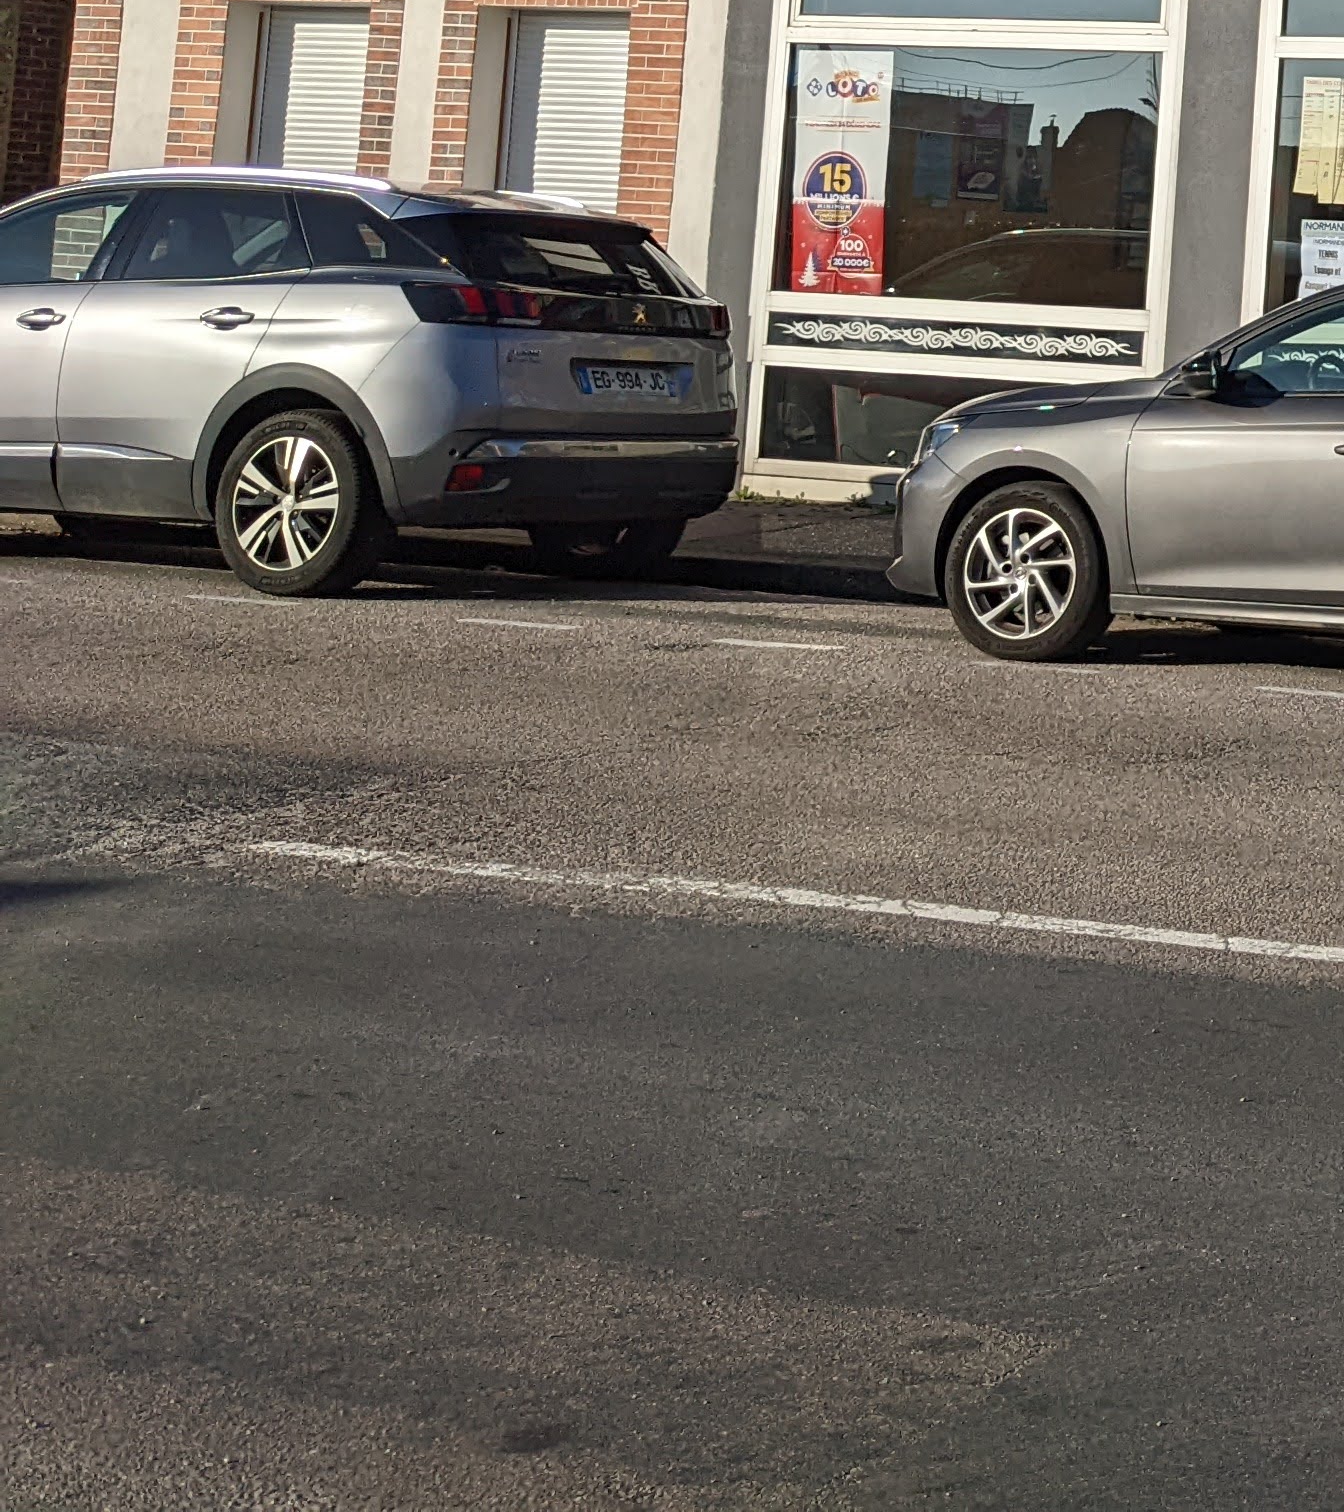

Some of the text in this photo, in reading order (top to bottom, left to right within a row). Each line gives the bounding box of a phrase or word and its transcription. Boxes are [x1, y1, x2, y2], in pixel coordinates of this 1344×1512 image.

[826, 76, 879, 98] LOTO
[819, 162, 852, 193] 15
[839, 239, 864, 252] 100
[832, 257, 844, 266] 20
